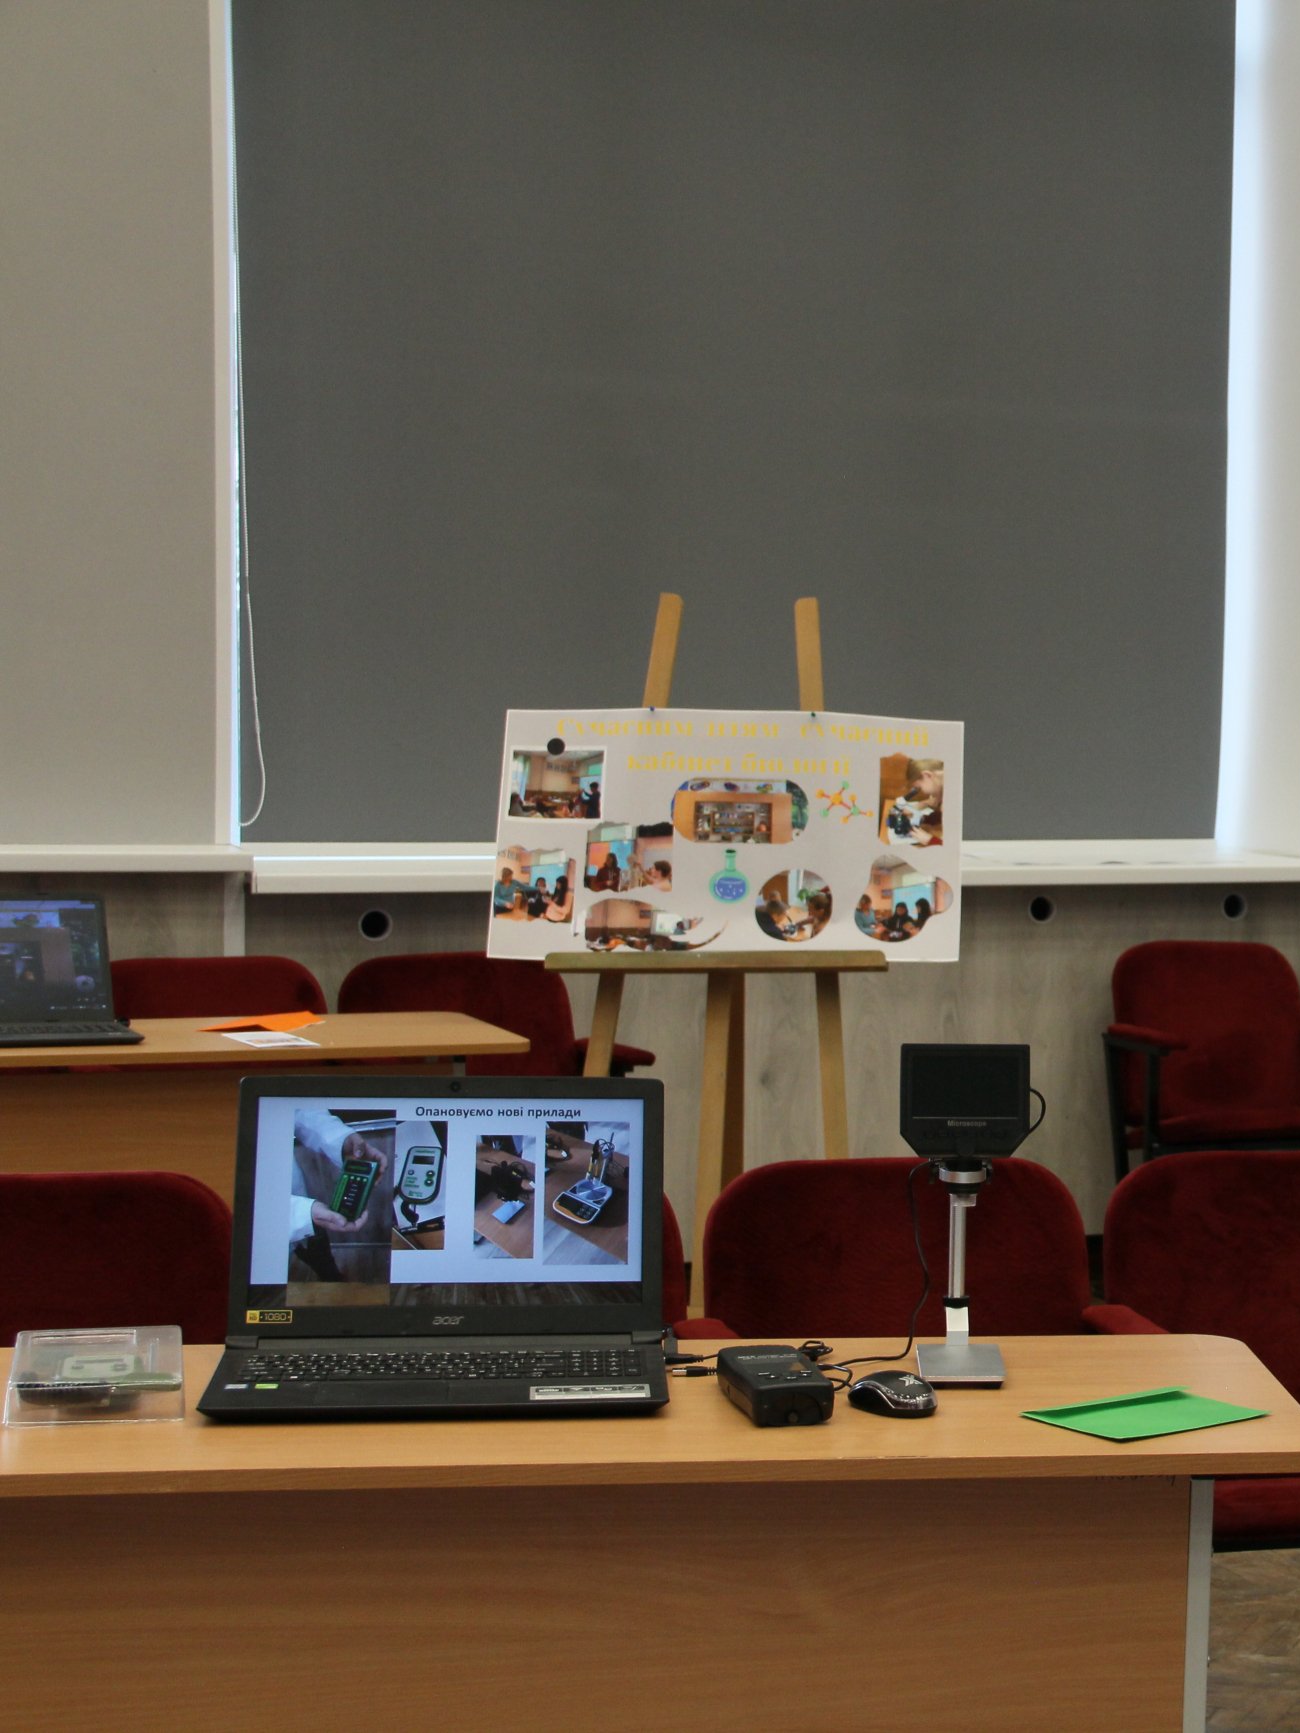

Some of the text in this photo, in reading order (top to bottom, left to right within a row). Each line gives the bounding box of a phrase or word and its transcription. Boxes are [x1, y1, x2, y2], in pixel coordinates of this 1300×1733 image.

[415, 1106, 582, 1119] Опановуємо нові прилади
[432, 1316, 465, 1325] acer
